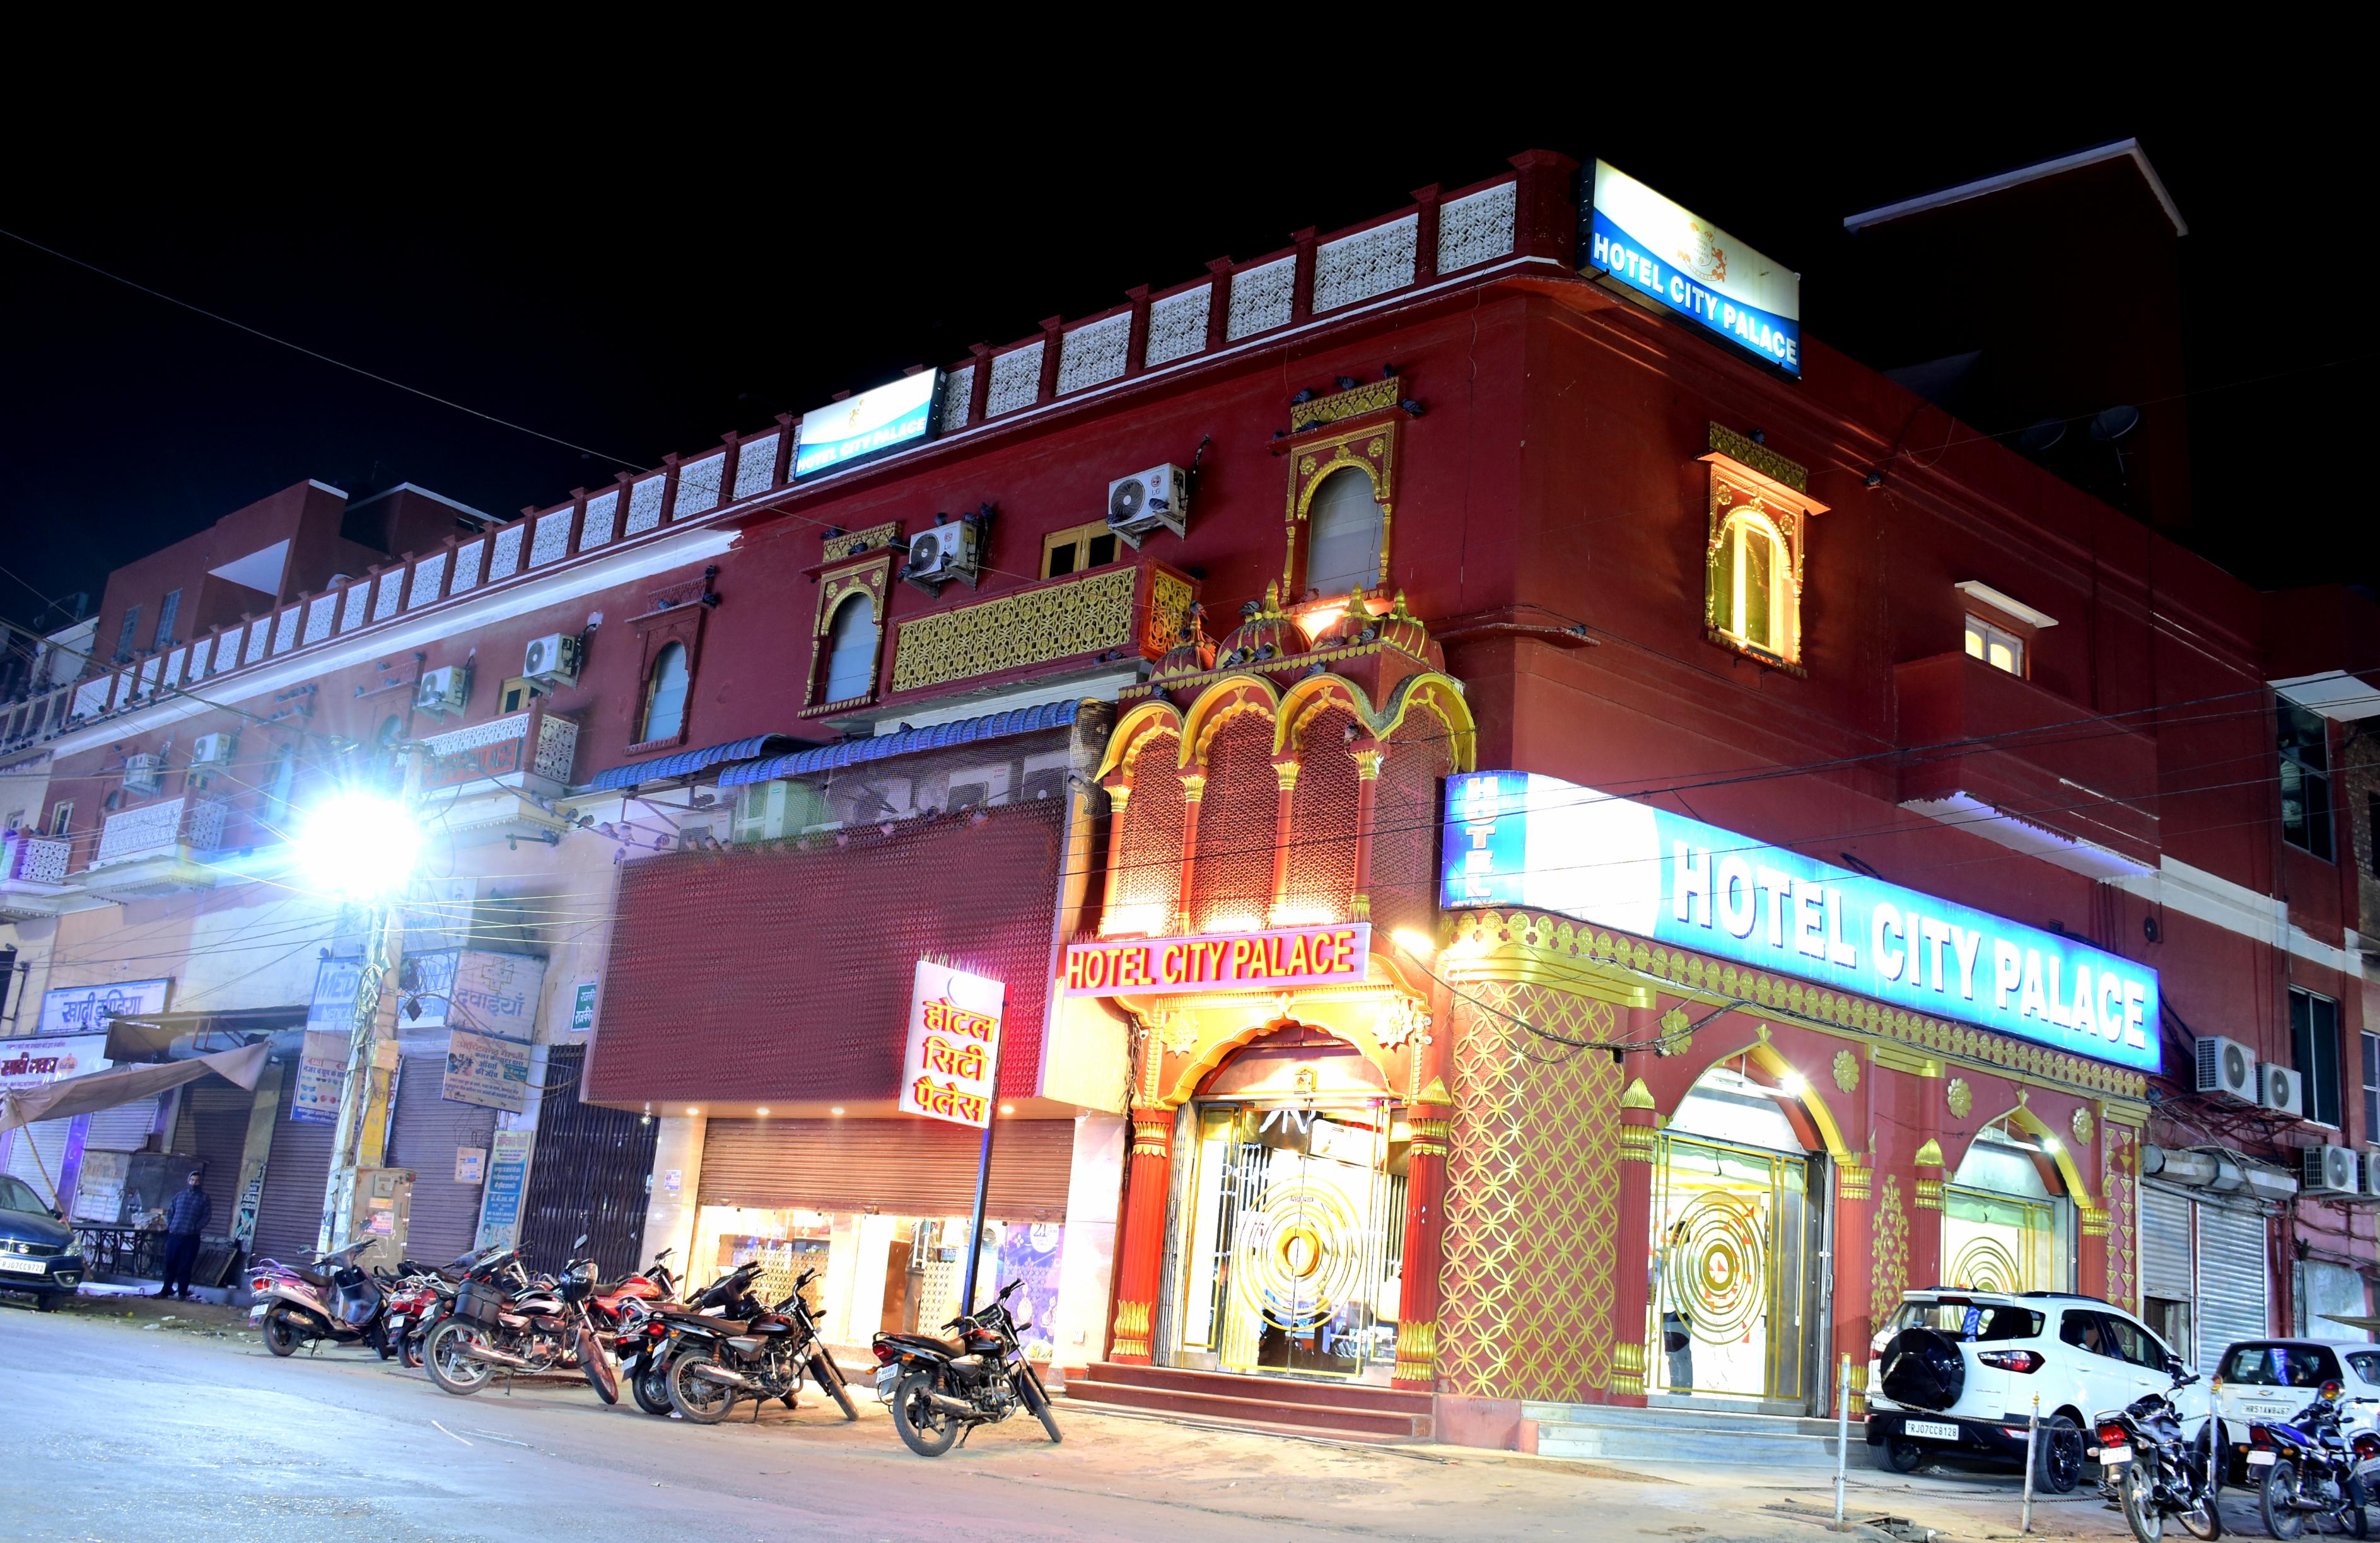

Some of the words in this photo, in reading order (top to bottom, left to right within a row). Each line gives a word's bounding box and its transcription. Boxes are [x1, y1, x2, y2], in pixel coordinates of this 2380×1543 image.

[1594, 232, 1664, 294] HOTEL
[1670, 275, 1718, 322] CITY
[1723, 302, 1799, 366] PALACE
[796, 445, 837, 473] HOTEL
[839, 433, 872, 455] CITY
[873, 417, 927, 446] PALACE
[1152, 487, 1161, 496] LG
[1464, 776, 1499, 899] HOTEL
[1067, 947, 1157, 989] HOTEL
[1162, 940, 1229, 984] CITY
[1232, 930, 1356, 980] PALACE
[1672, 839, 1857, 969] HOTEL
[1870, 902, 1981, 1001] CITY
[1994, 938, 2145, 1051] PALACE
[62, 991, 95, 1025] खादी
[322, 1007, 353, 1022] MEDICA
[575, 1006, 593, 1025] राजकी
[580, 988, 596, 1002] राजकी
[922, 997, 998, 1042] होटल
[922, 1035, 989, 1081] सिटी
[913, 1075, 989, 1122] पैलेस
[1911, 1423, 1957, 1437] RJ07CC8128
